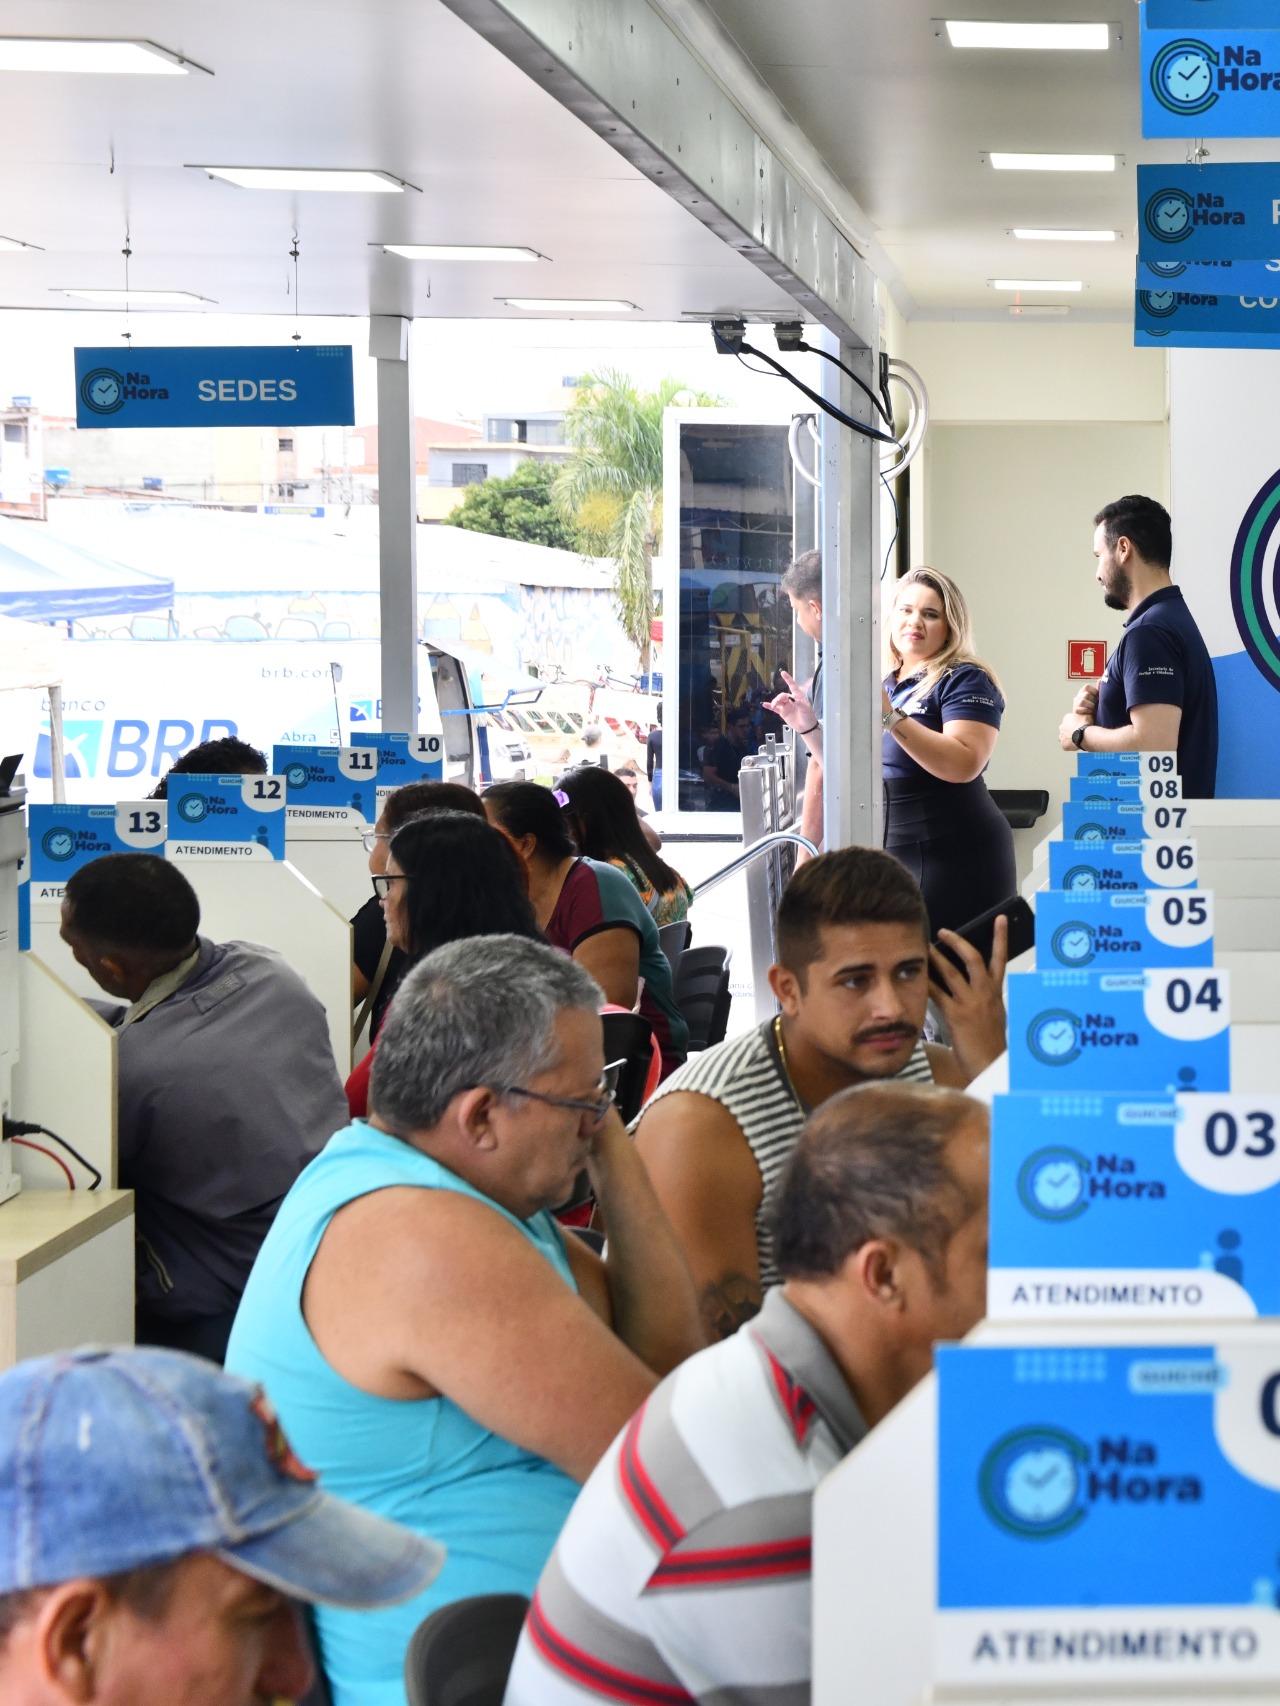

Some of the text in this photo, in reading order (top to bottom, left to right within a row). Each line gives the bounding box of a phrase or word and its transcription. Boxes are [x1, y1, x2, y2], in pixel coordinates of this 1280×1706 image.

[1224, 45, 1261, 66] Na
[1198, 193, 1224, 208] Na
[1193, 208, 1246, 226] Hora
[1177, 292, 1218, 306] Hora
[126, 372, 150, 385] Na
[122, 386, 169, 400] Hora
[198, 379, 297, 402] SEDES
[280, 731, 317, 742] Abra
[417, 737, 440, 752] 10
[349, 753, 373, 769] 11
[1148, 756, 1174, 772] 09
[310, 766, 325, 774] Na
[307, 774, 336, 782] Hora
[253, 780, 282, 799] 12
[1150, 780, 1178, 798] 08
[209, 796, 226, 805] Na
[206, 805, 238, 815] Hora
[287, 809, 348, 819] TENDIMENTO
[1154, 807, 1187, 828] 07
[129, 811, 161, 833] 13
[78, 831, 97, 840] Na
[1108, 826, 1126, 836] Na
[74, 841, 111, 851] Hora
[175, 846, 253, 856] ATENDIMENTO
[1156, 845, 1194, 869] 06
[1102, 869, 1123, 879] Na
[1099, 881, 1138, 890] Hora
[1163, 897, 1207, 926] 05
[1099, 926, 1123, 937] Na
[1094, 940, 1142, 952] Hora
[1166, 978, 1222, 1013] 04
[1086, 1014, 1116, 1028] Na
[1080, 1031, 1139, 1047] Hora
[1204, 1111, 1276, 1157] 03
[1096, 1154, 1135, 1174] Na
[1088, 1176, 1165, 1199] Hora
[1012, 1284, 1203, 1306] ATENDIMENTO
[1097, 1437, 1158, 1466] Na
[1087, 1470, 1204, 1504] Hora
[972, 1632, 1259, 1663] ATENDIMENTO
